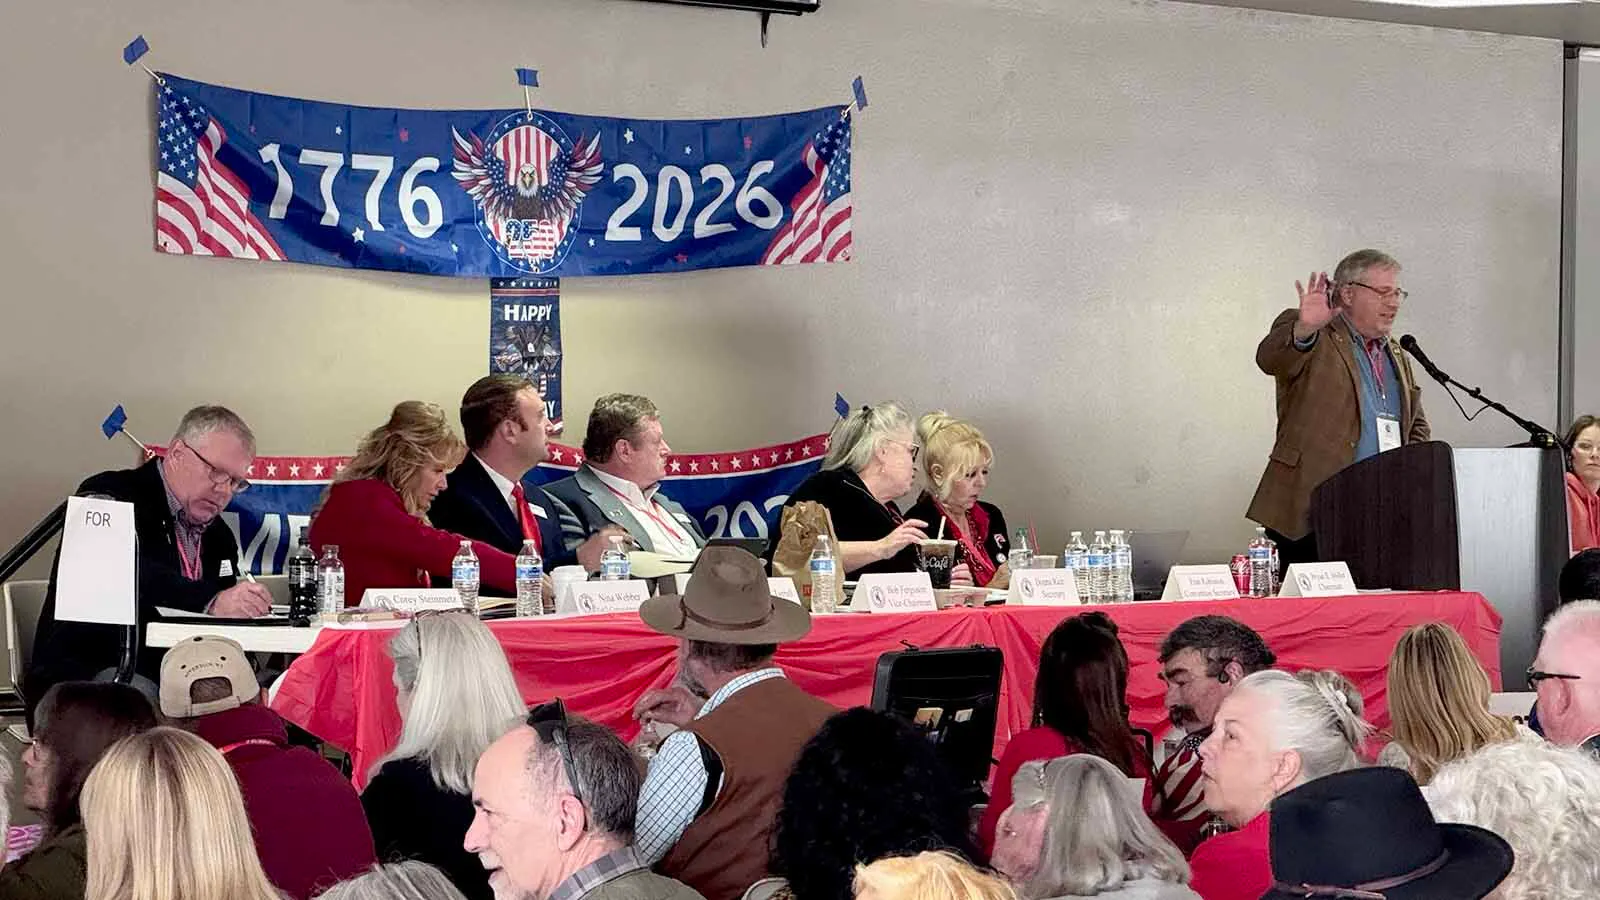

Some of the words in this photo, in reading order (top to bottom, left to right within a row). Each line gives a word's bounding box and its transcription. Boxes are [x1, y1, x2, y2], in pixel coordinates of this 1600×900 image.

[258, 142, 443, 239] 1776
[604, 160, 784, 242] 2026
[505, 218, 556, 259] 250
[504, 304, 553, 321] HAPPY
[85, 510, 112, 528] FOR
[392, 594, 417, 606] Corey
